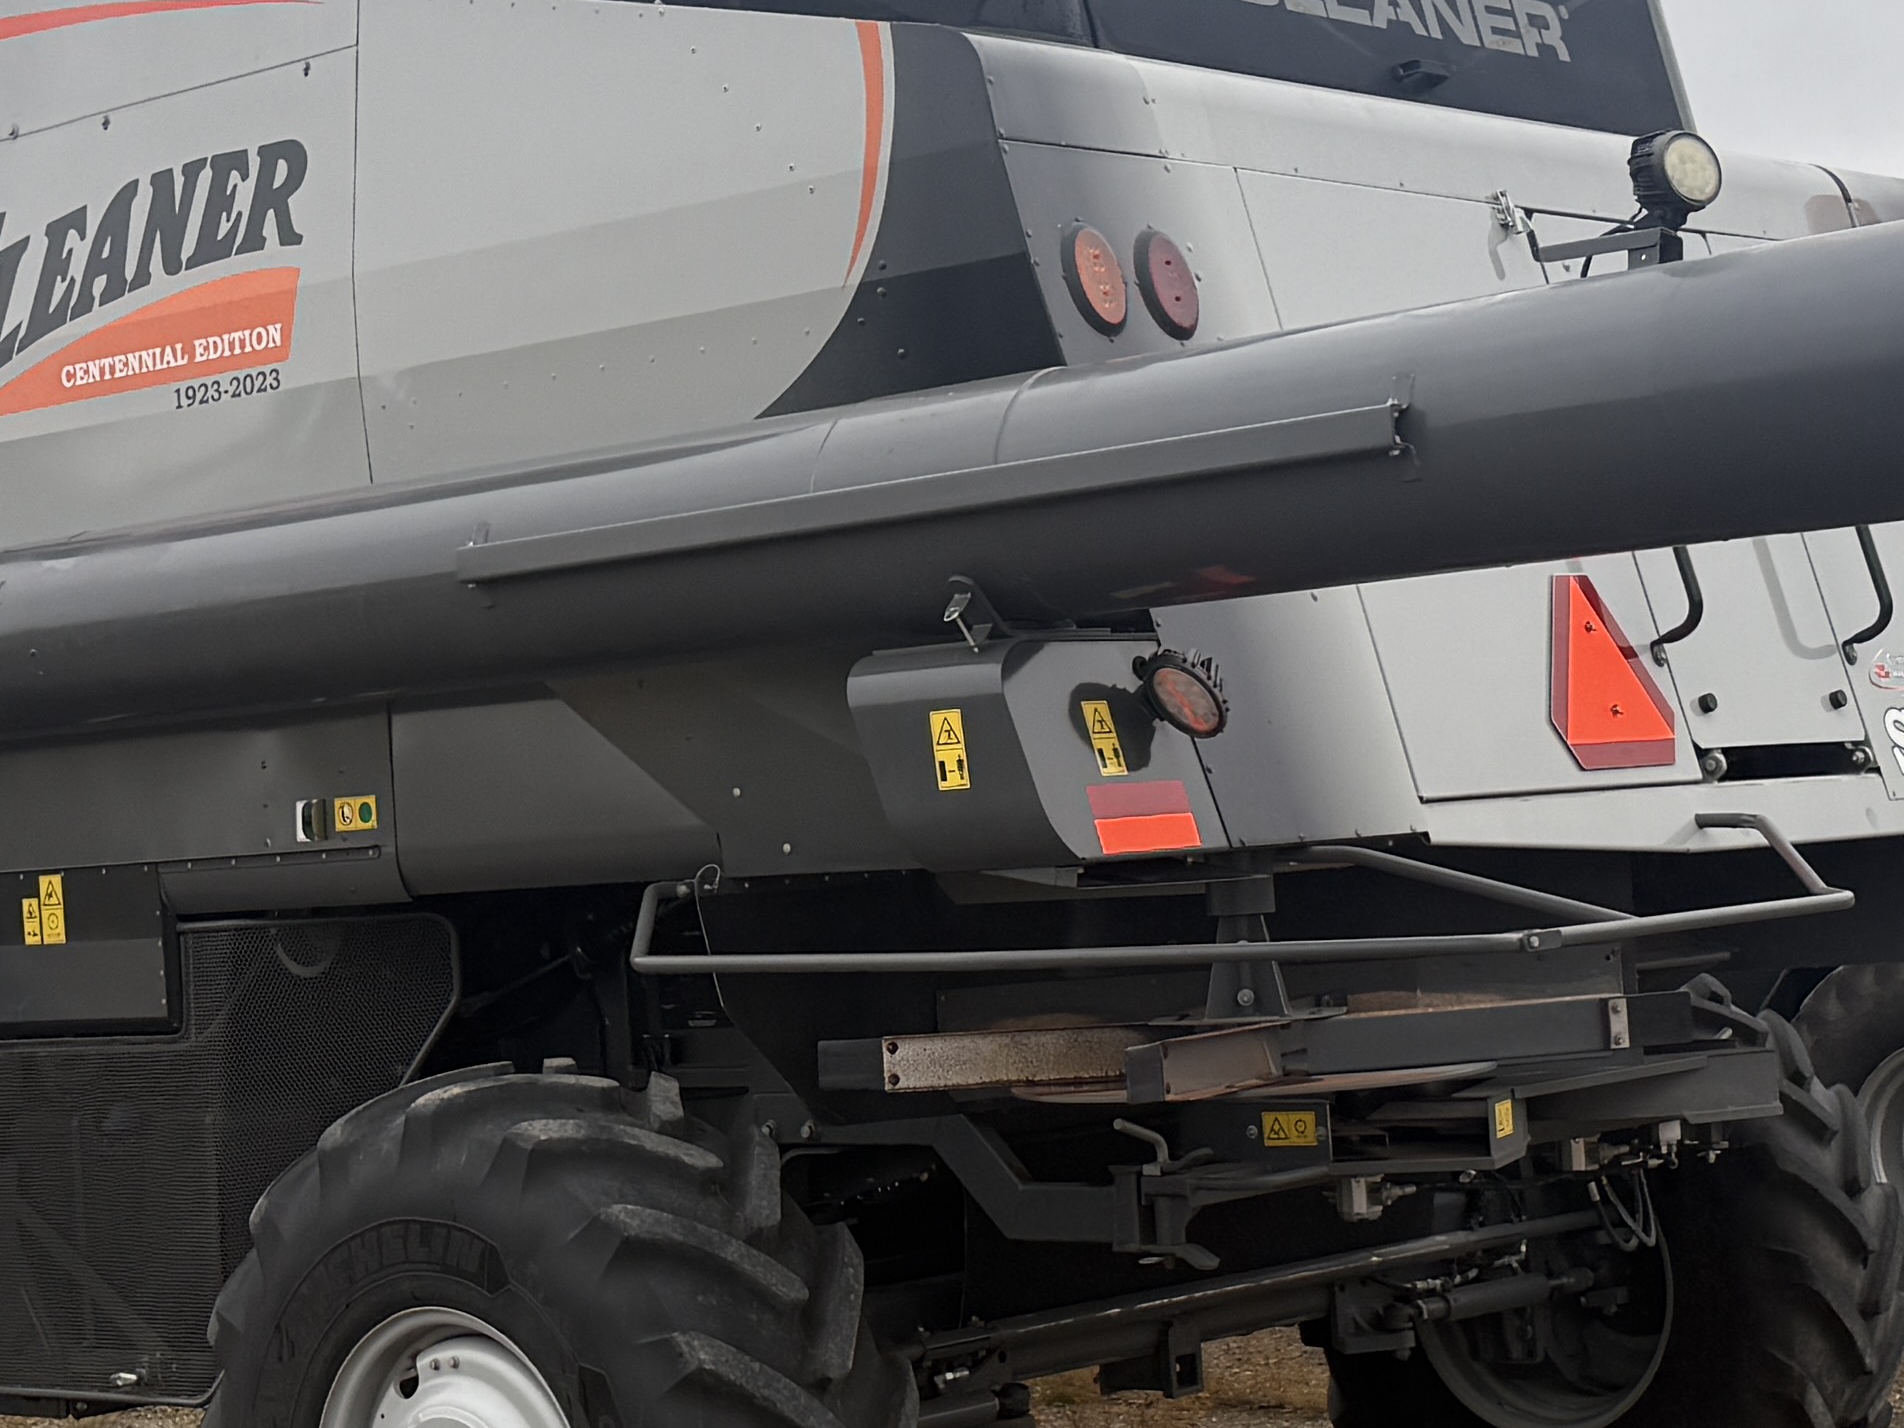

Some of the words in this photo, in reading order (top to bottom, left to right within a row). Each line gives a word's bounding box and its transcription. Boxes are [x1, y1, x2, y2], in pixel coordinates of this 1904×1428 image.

[60, 343, 189, 388] CENTENNIAL
[192, 323, 283, 363] EDITION
[173, 368, 282, 410] 1923-2023
